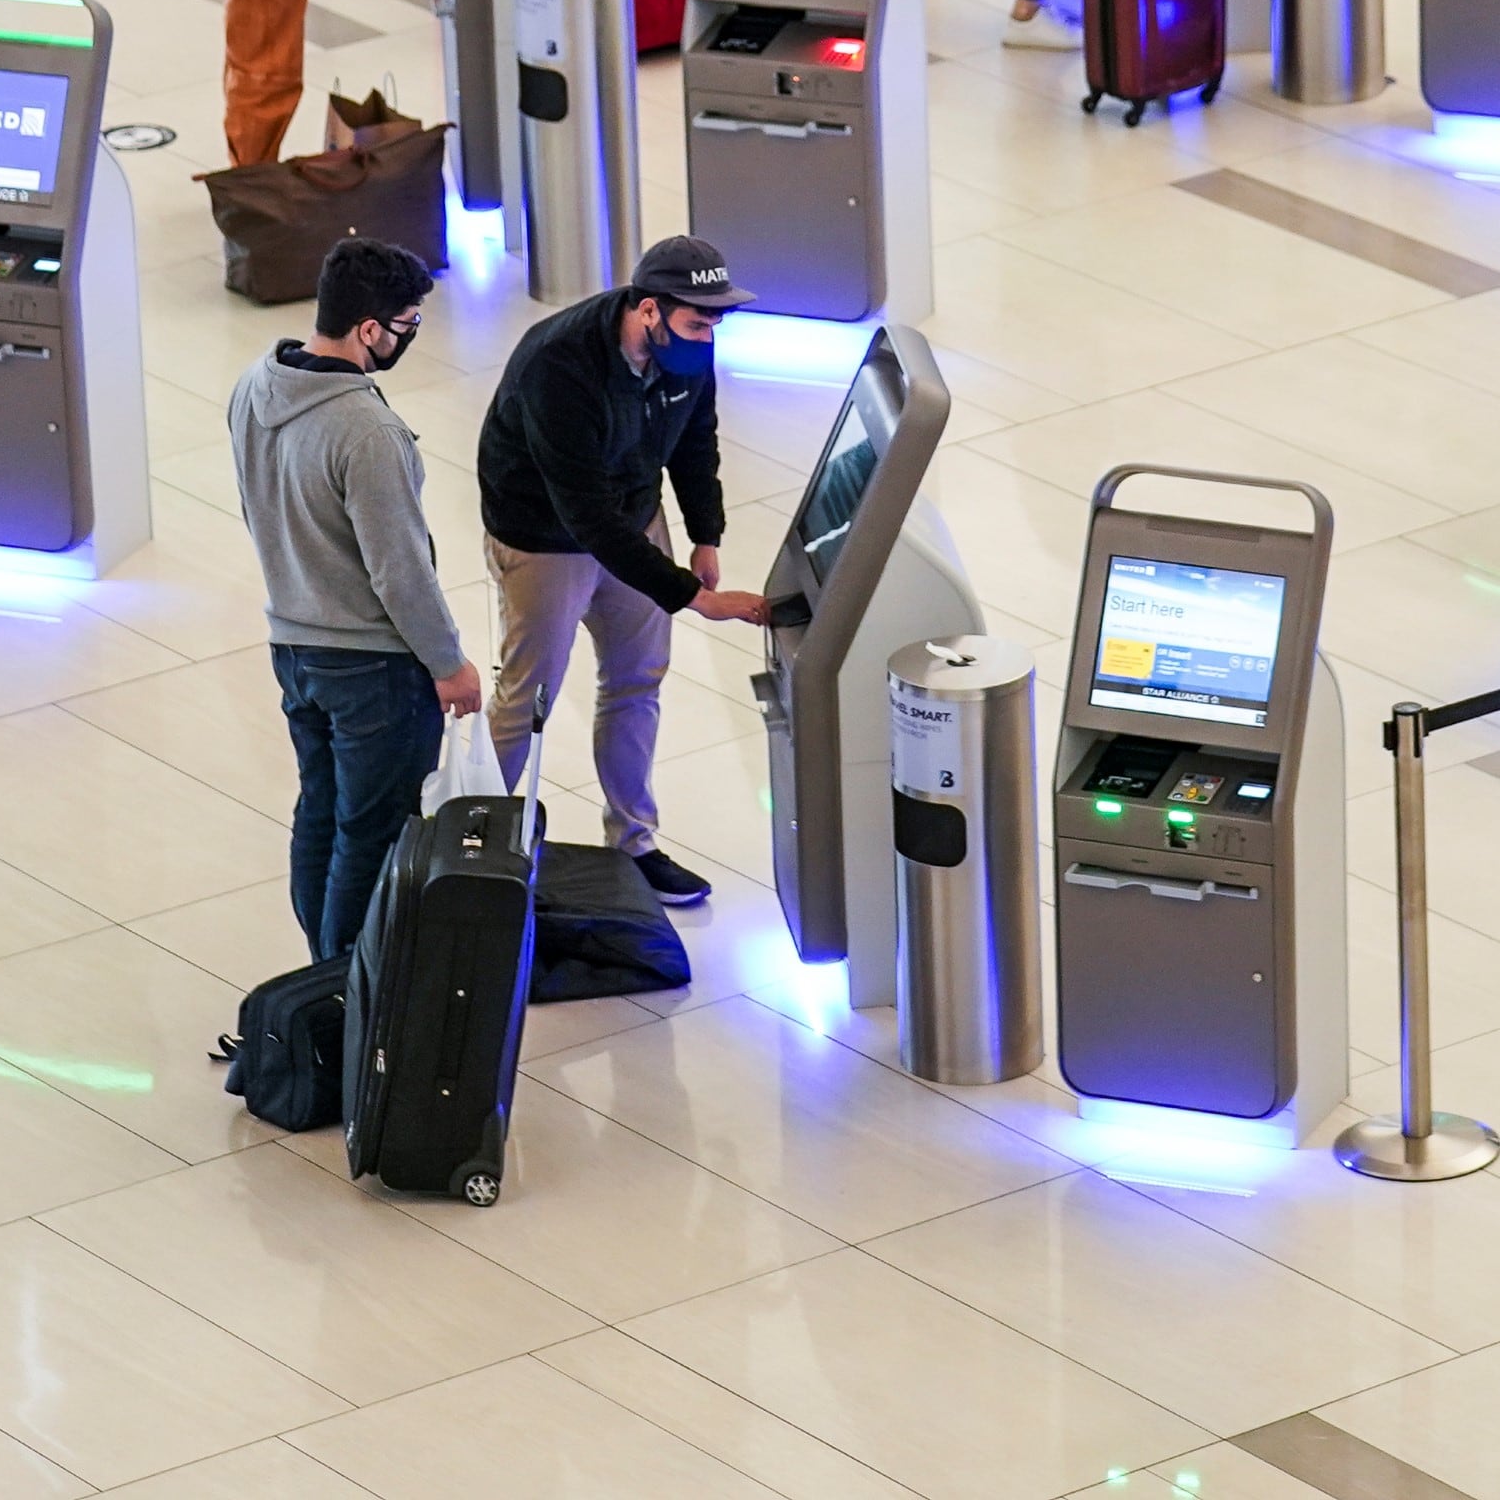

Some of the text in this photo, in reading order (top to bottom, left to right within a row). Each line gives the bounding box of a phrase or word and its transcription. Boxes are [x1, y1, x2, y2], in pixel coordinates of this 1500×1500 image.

[1110, 595, 1185, 619] Start here
[1142, 687, 1210, 704] STAR ALLIANCE
[909, 706, 953, 723] SMART.
